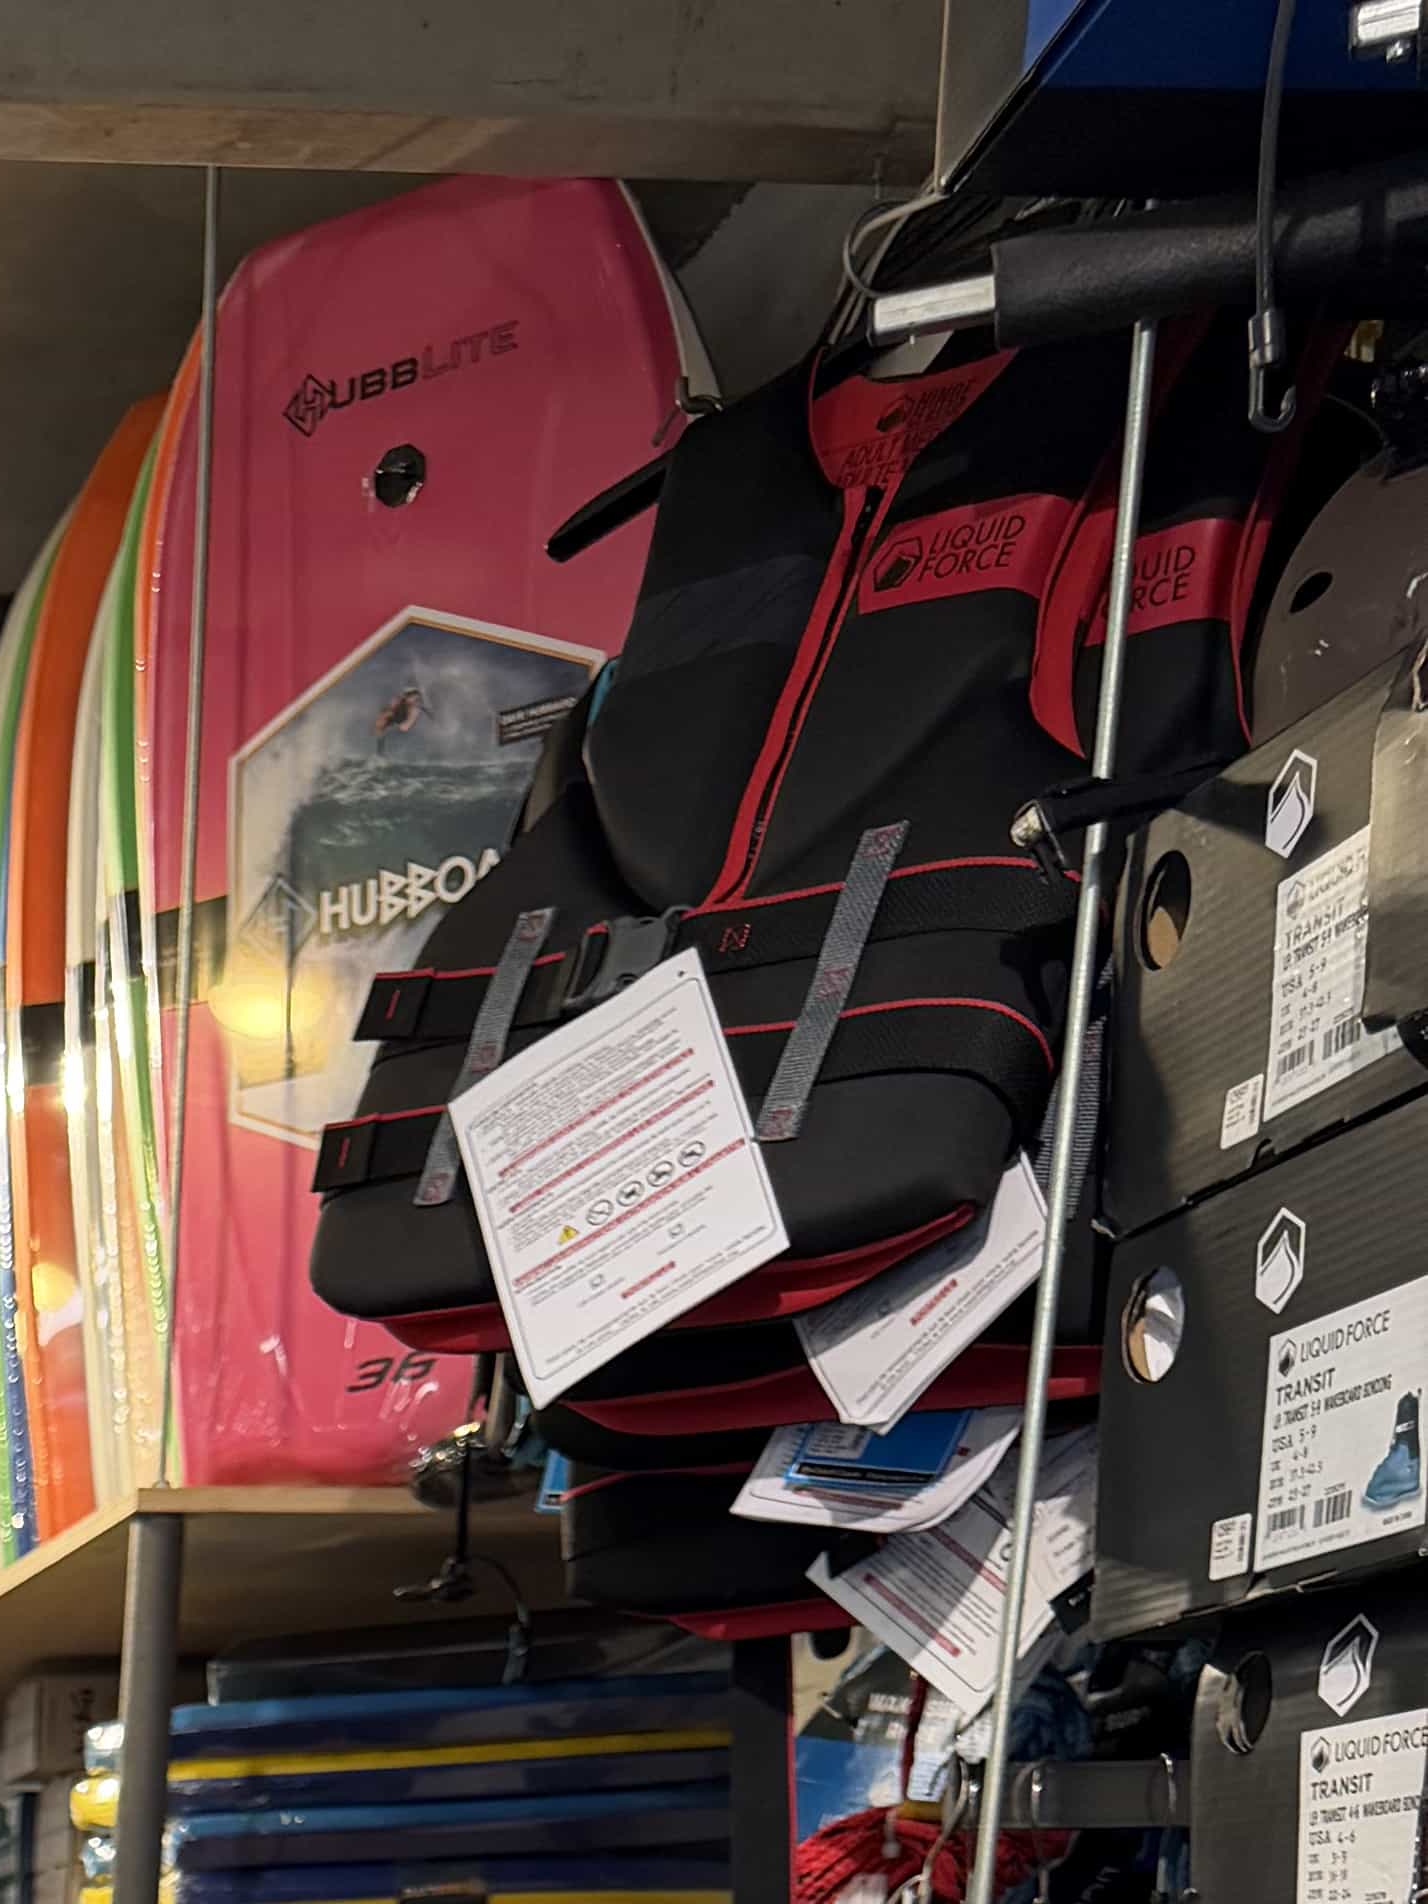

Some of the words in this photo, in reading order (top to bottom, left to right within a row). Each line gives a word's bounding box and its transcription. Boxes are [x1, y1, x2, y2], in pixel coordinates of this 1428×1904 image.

[929, 515, 1026, 555] LIQUID
[917, 541, 1017, 583] FORCE
[1284, 901, 1344, 949] TRANSIT
[346, 1351, 437, 1393] 36
[1276, 1368, 1336, 1406] TRANSIT
[1311, 1772, 1374, 1800] TRANSIT
[1309, 1831, 1331, 1846] USA
